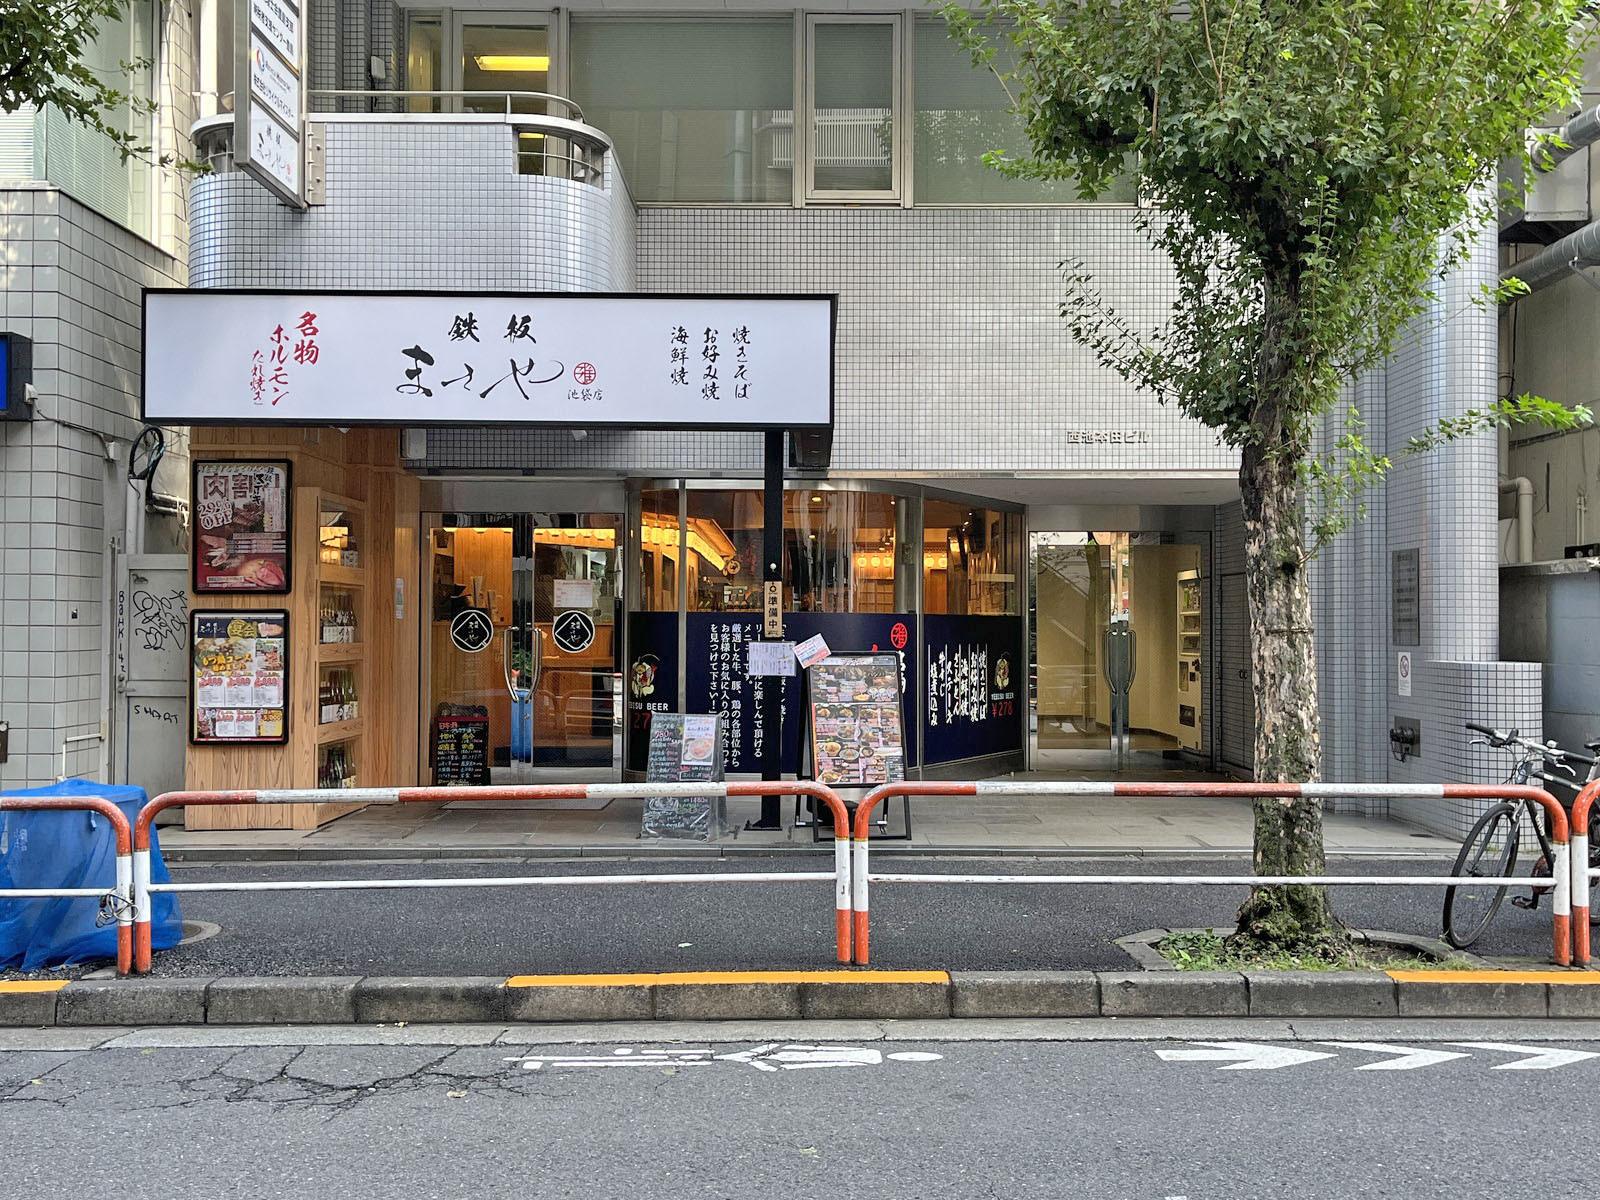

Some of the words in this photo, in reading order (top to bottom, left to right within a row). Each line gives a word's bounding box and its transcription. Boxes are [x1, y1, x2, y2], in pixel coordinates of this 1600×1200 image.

[293, 311, 320, 365] 名物
[447, 311, 537, 344] 鉄板
[670, 325, 690, 386] 海鮮焼
[249, 349, 266, 406] たれ焼き
[268, 323, 290, 406] ホルモン
[396, 344, 565, 401] まさや
[701, 326, 721, 401] お好み焼
[732, 325, 752, 400] 焼きそば
[567, 388, 604, 402] 池袋店
[202, 511, 233, 529] OFF
[768, 596, 778, 629] 準備中
[646, 703, 669, 711] BEER
[753, 624, 763, 758] リールに楽しんで頂ける
[960, 658, 969, 716] 海鮮焼
[970, 651, 979, 722] お好み焼
[979, 650, 987, 720] 焼きそば
[991, 693, 1005, 701] YEBISU
[1005, 692, 1014, 700] BEER
[991, 701, 1014, 718] ¥278
